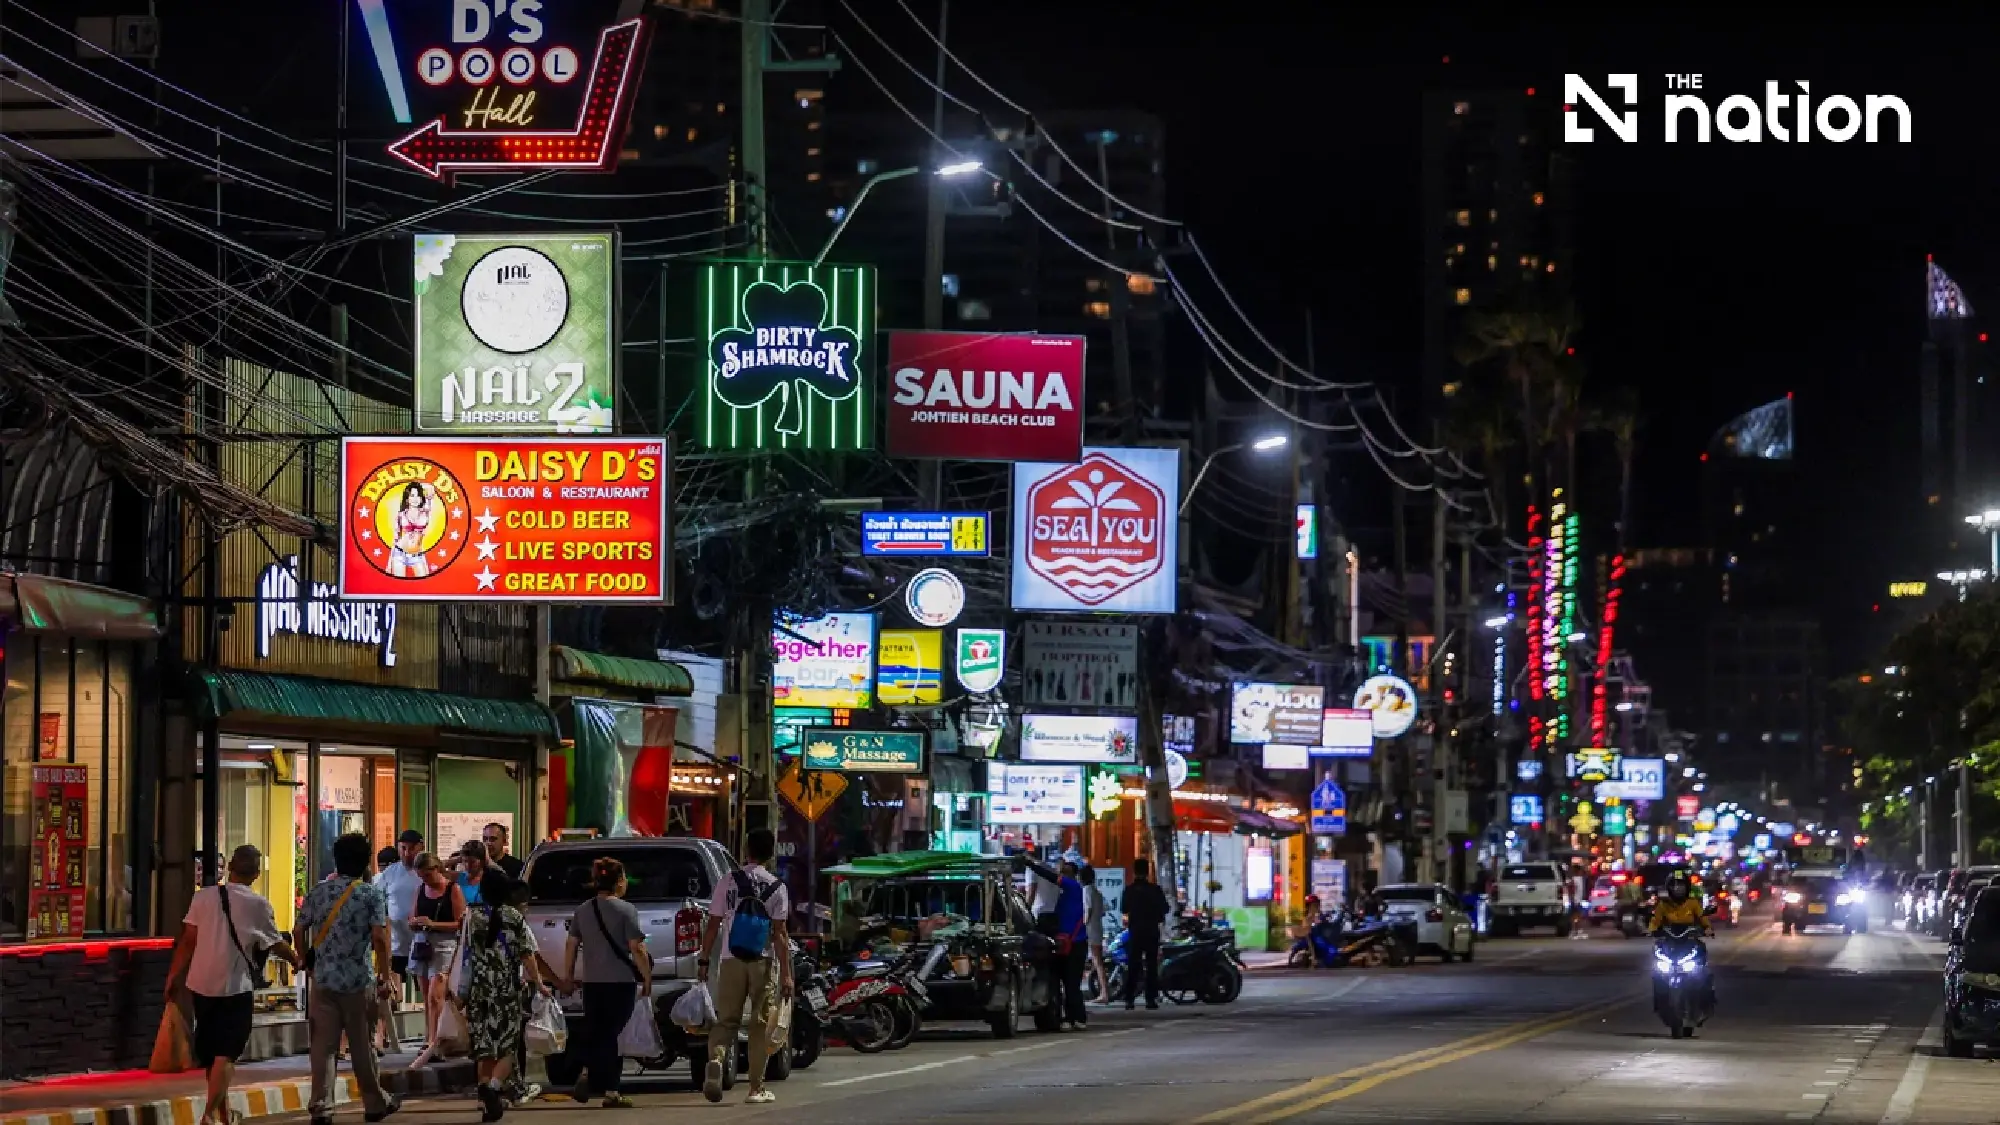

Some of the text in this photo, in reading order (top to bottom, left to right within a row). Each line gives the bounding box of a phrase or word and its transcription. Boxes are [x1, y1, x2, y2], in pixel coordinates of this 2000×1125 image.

[426, 53, 571, 80] POOL
[463, 86, 537, 128] Hall
[755, 326, 816, 347] DIRTY
[721, 341, 850, 382] SHAMROCK
[544, 362, 590, 424] 2
[893, 368, 1073, 411] SAUNA
[461, 410, 541, 423] MASSAGE
[910, 410, 1056, 427] JOMTIEN BEACH CLUB
[474, 449, 591, 482] DAISY
[360, 461, 433, 503] DAISY
[481, 486, 650, 499] SALOON & RESTAURANT
[505, 510, 631, 530] COLD BEER
[1034, 515, 1156, 544] SEA YOU
[505, 541, 653, 561] LIVE SPORTS
[505, 572, 648, 592] GREAT FOOD
[307, 582, 382, 645] MASSAGE
[772, 636, 869, 663] ogether
[797, 666, 839, 682] bar
[842, 735, 884, 748] G & N
[842, 747, 907, 763] Massage
